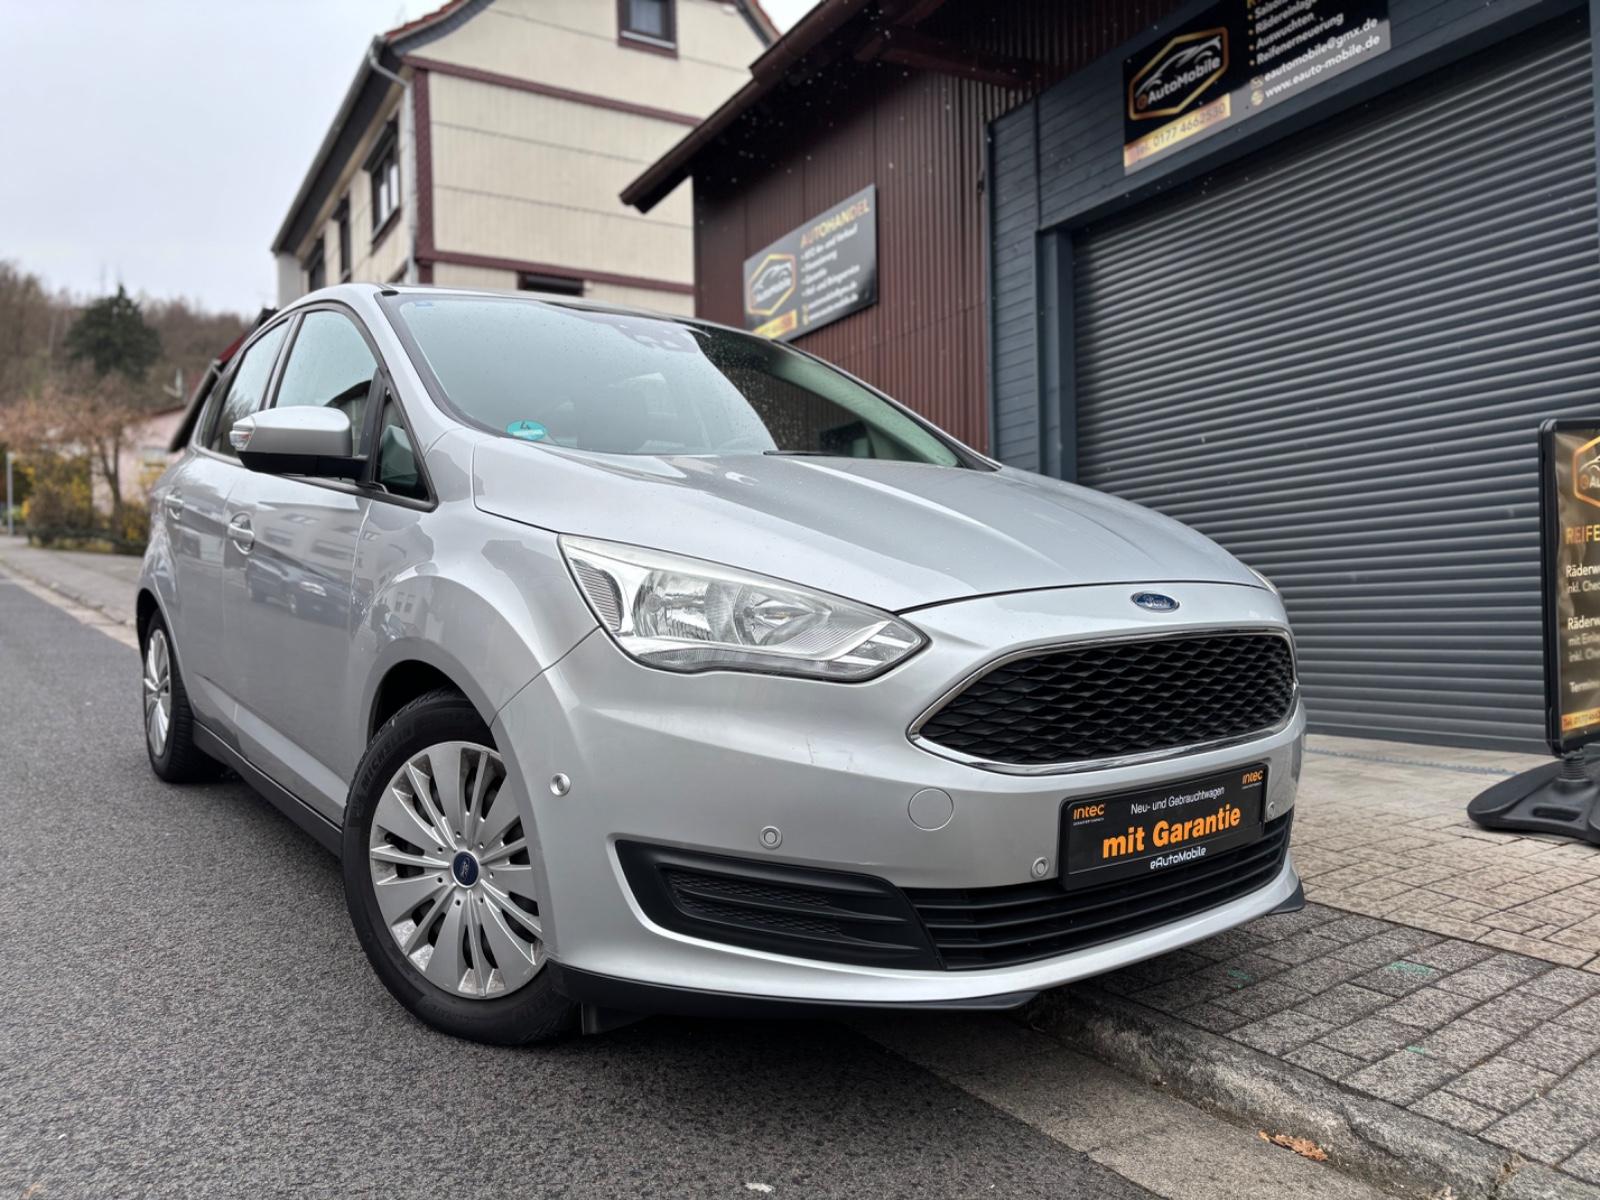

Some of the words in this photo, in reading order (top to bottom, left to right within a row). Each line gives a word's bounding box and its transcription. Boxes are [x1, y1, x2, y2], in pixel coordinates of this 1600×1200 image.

[1256, 12, 1314, 50] Auswuchten
[1256, 13, 1344, 65] Reifenerneuerung
[1264, 18, 1378, 82] eautomobile@gmx.de
[1264, 35, 1380, 98] www.eauto-mobile.de
[1152, 127, 1178, 147] 0177
[1073, 803, 1105, 820] intec
[1131, 801, 1150, 815] Neu-
[1152, 798, 1167, 811] und
[1168, 786, 1225, 806] Gebrauchtwagen
[1102, 825, 1145, 859] mit
[1152, 803, 1241, 847] Garantie
[1150, 846, 1206, 870] eAutoMobile
